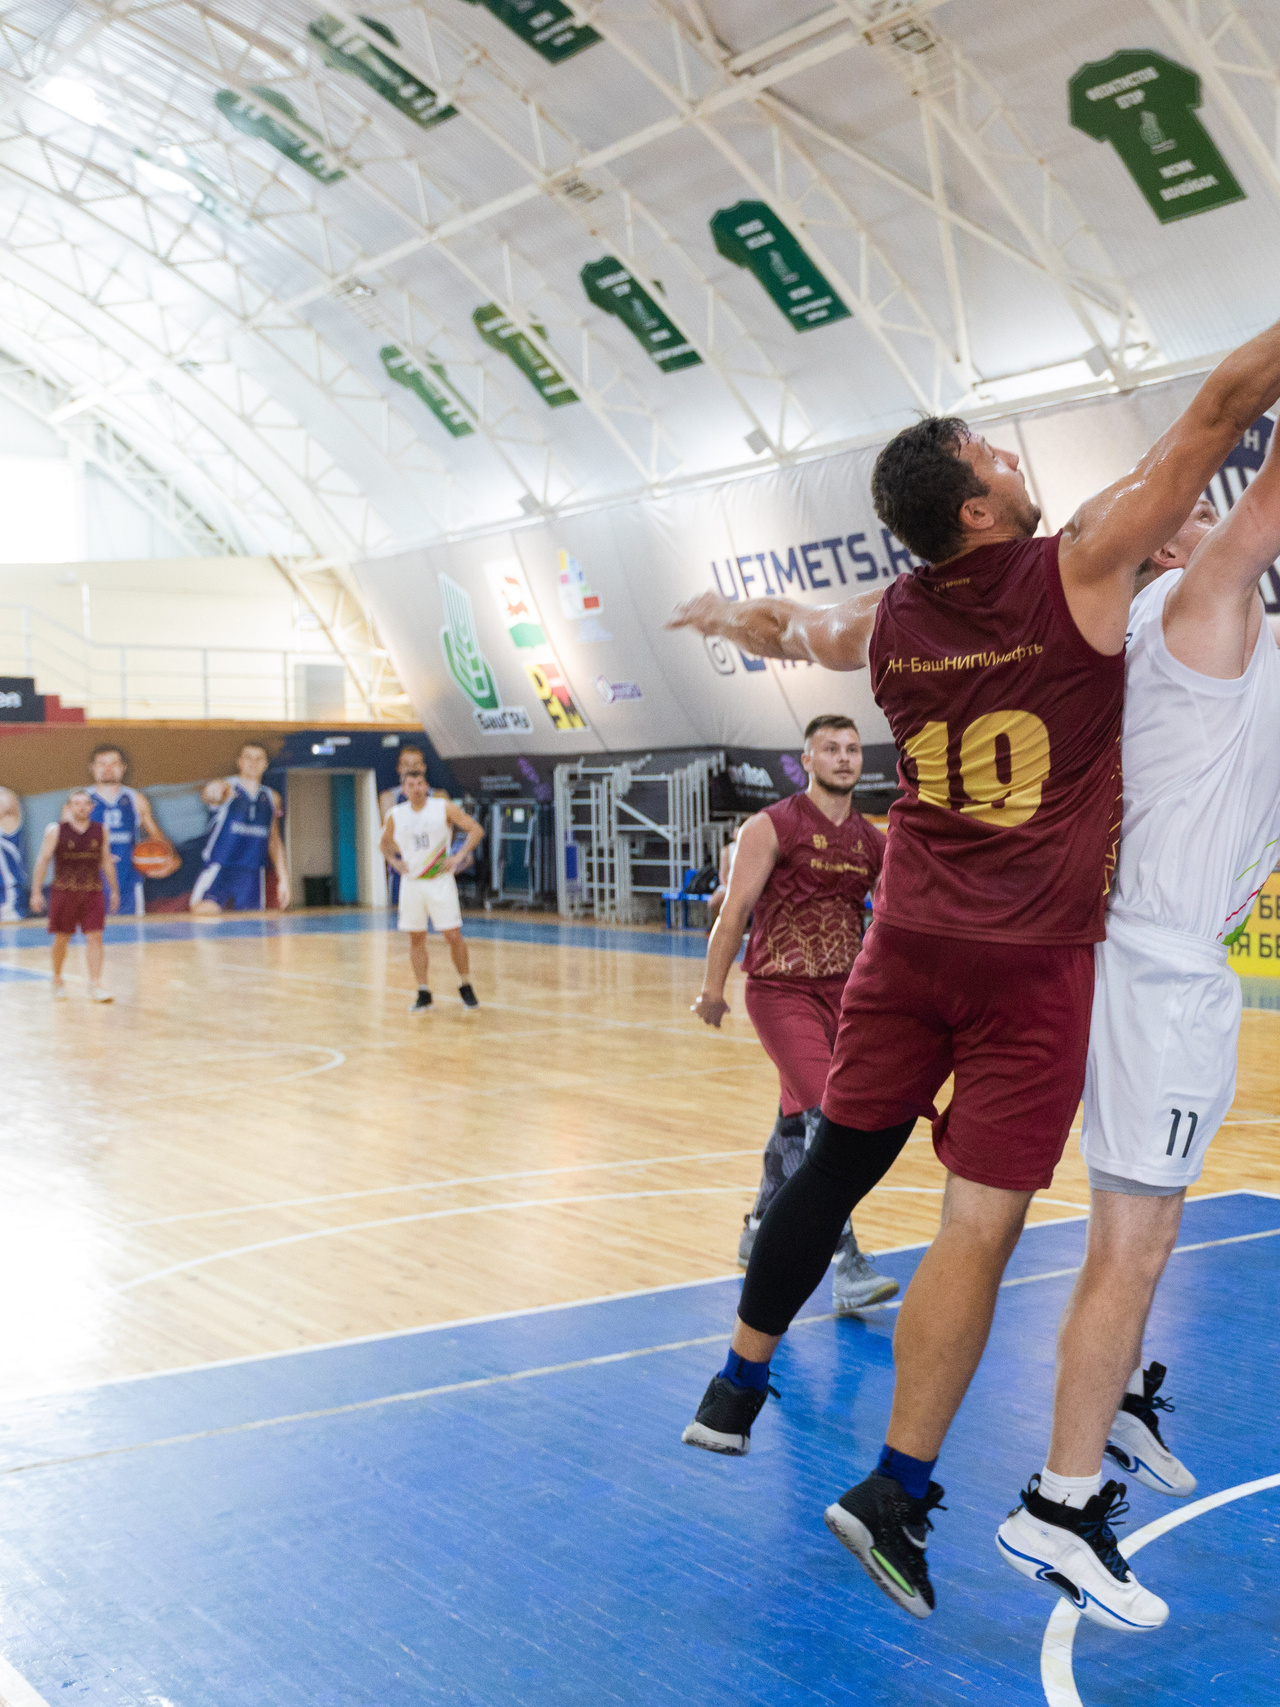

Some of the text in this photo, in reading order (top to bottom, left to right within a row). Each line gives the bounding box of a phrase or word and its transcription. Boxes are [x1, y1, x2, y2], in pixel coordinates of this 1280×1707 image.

[712, 528, 927, 600] UFIMETS.R
[889, 643, 1043, 673] Н-БашНИПИнефть
[904, 710, 1050, 827] 19
[1165, 1108, 1198, 1159] 11
